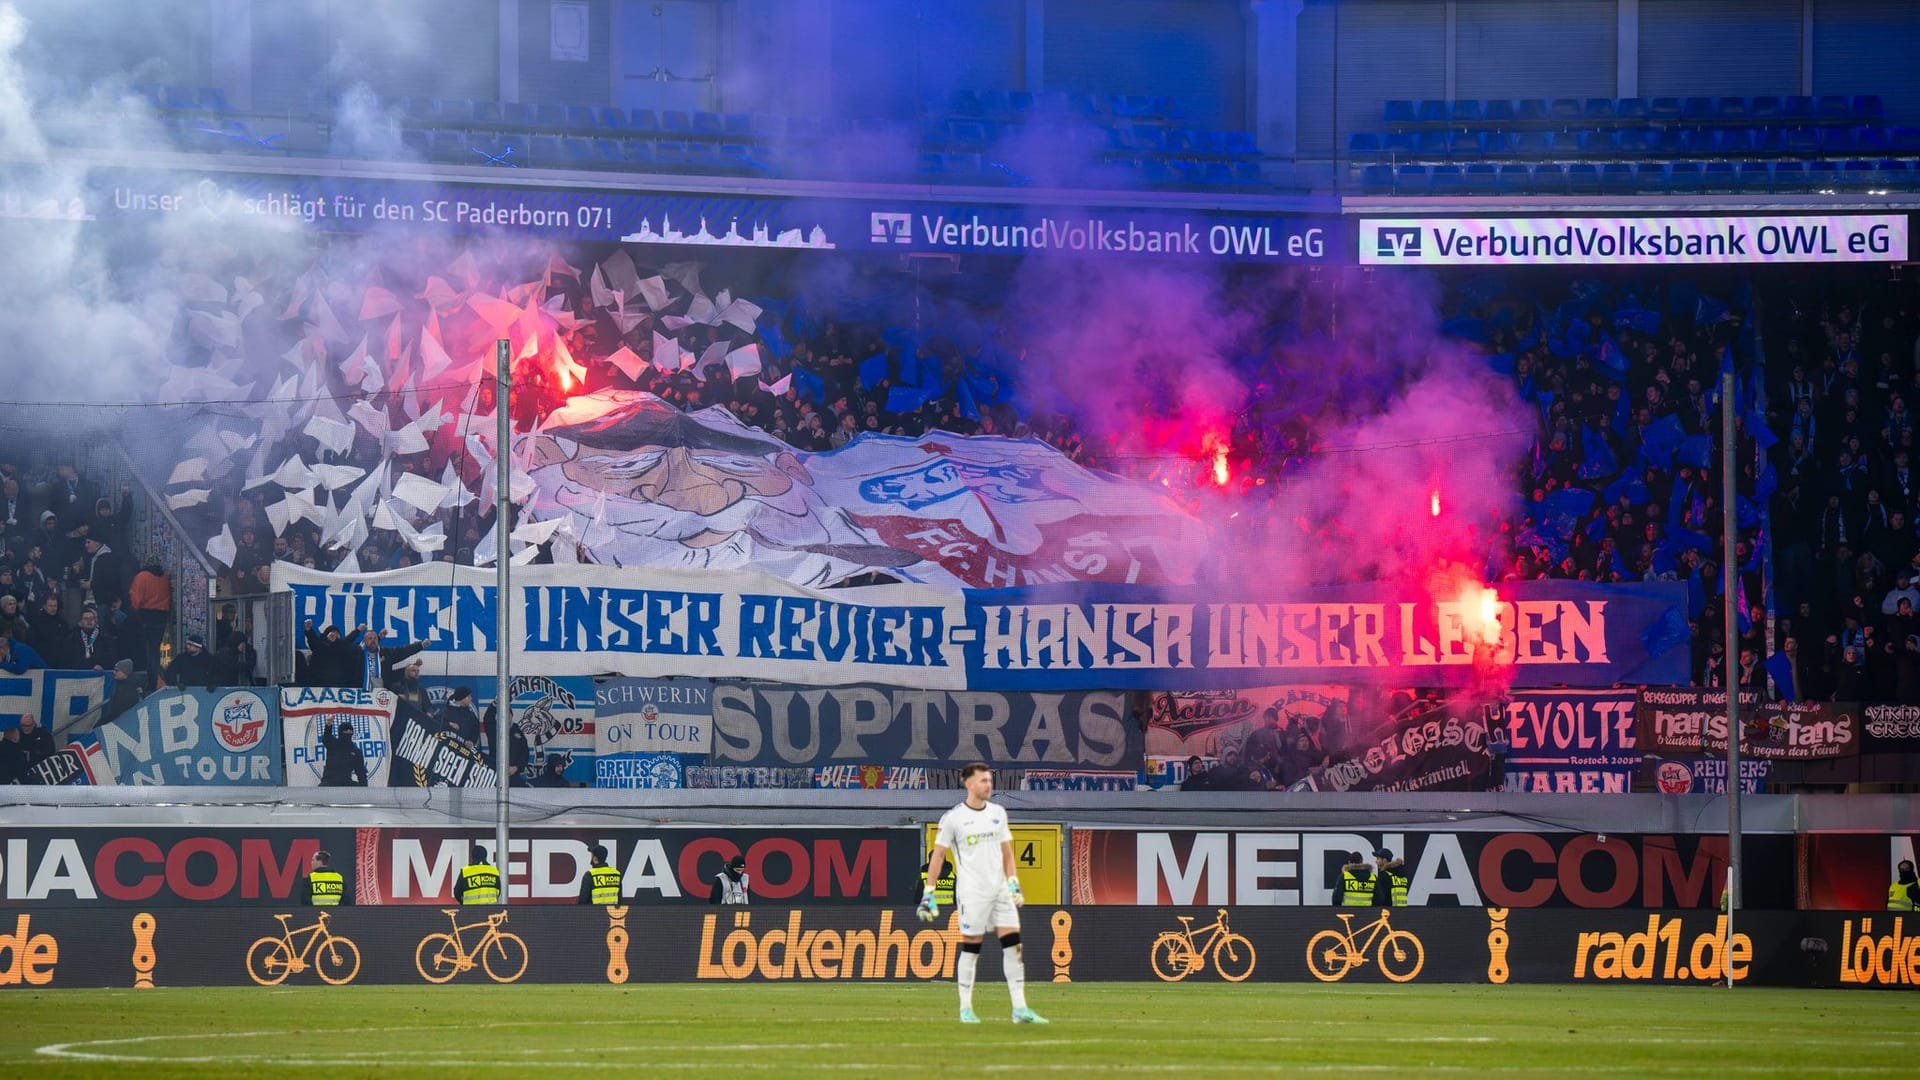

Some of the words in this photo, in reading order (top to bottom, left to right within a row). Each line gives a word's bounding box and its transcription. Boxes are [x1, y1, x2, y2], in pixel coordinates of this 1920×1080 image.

[115, 187, 183, 211] Unser
[244, 192, 326, 222] schlägt
[333, 195, 365, 218] für
[373, 197, 414, 221] den
[423, 200, 449, 222] SC
[456, 201, 569, 227] Paderborn
[577, 206, 612, 229] 07!
[920, 214, 1200, 254] VerbundVolksbank
[1209, 224, 1279, 256] OWL
[1287, 227, 1324, 257] eG
[1433, 225, 1746, 256] VerbundVolksbank
[1756, 225, 1837, 254] OWL
[1847, 224, 1890, 253] eG
[287, 582, 497, 652] RÜGEN
[523, 585, 725, 657] UNSER
[1206, 601, 1390, 668] UNSER
[506, 674, 576, 711] ANATICS
[596, 686, 708, 706] SCHWERIN
[1152, 691, 1256, 722] Action
[563, 717, 584, 733] 05
[607, 723, 632, 744] ON
[644, 723, 701, 743] TOUR
[712, 684, 1127, 767] SUPTRAS
[1505, 700, 1638, 750] EVOLTE
[1788, 712, 1853, 746] fans
[1570, 755, 1609, 765] Rostock
[1788, 744, 1809, 756] den
[175, 756, 271, 781] TOUR
[595, 758, 652, 777] GREVES
[1694, 760, 1768, 778] REUERS
[1503, 771, 1625, 793] WAREN
[1704, 778, 1757, 794] HAEN
[1021, 842, 1035, 866] 4
[697, 910, 960, 980] Löckenhof
[1574, 914, 1752, 980] rad1.de
